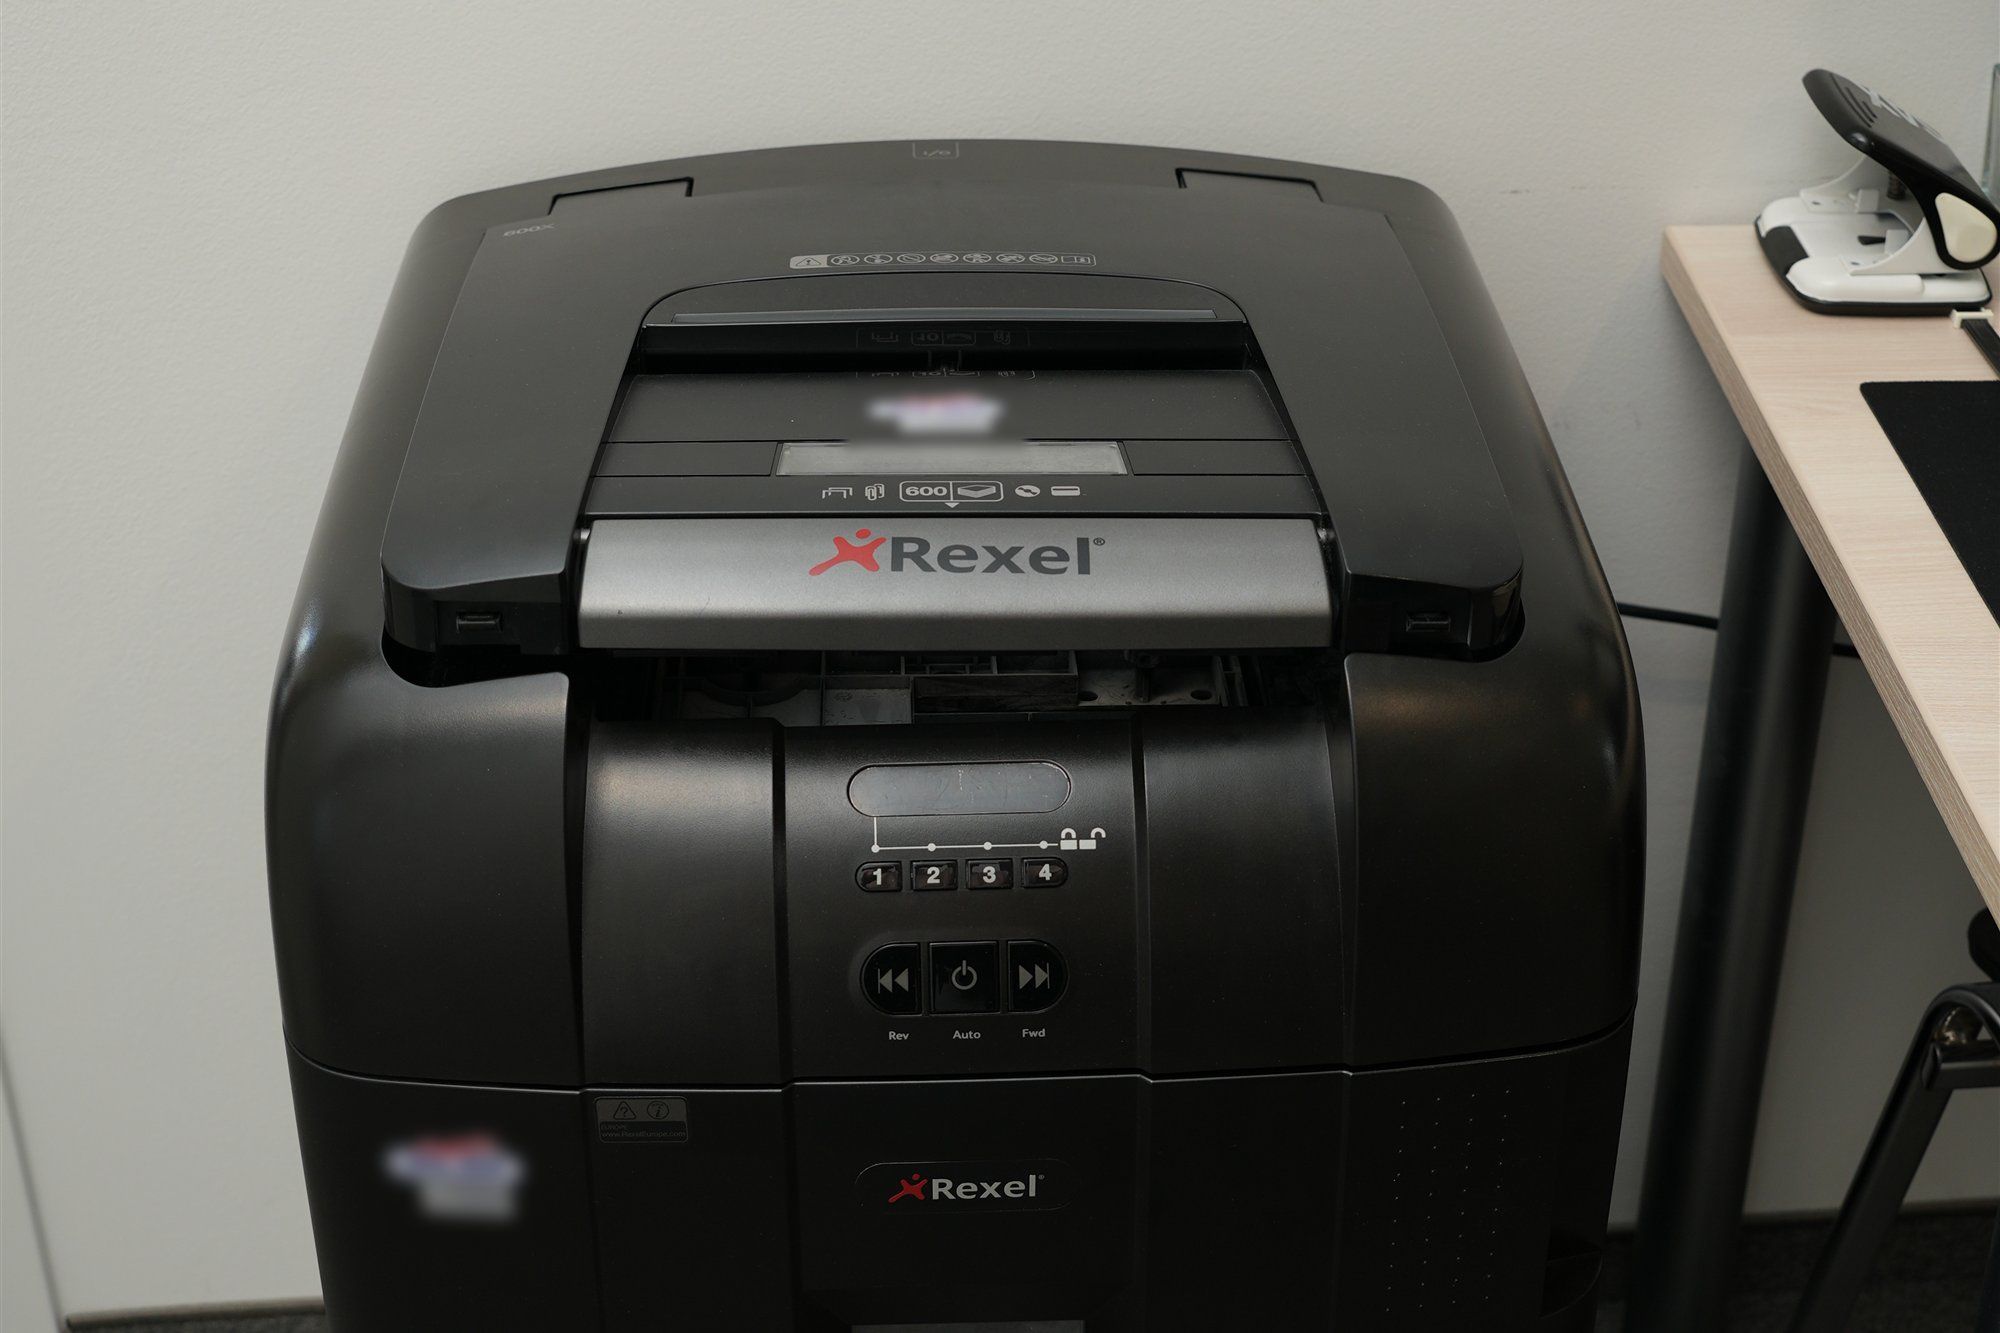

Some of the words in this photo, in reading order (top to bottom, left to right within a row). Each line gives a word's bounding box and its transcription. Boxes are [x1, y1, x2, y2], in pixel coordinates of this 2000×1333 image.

[905, 485, 948, 497] 600
[872, 868, 882, 886] 1
[926, 866, 941, 885] 2
[982, 866, 997, 884] 3
[1038, 863, 1053, 881] 4
[888, 1030, 910, 1041] Rev
[952, 1029, 981, 1040] Auto
[1022, 1027, 1046, 1038] Fwd
